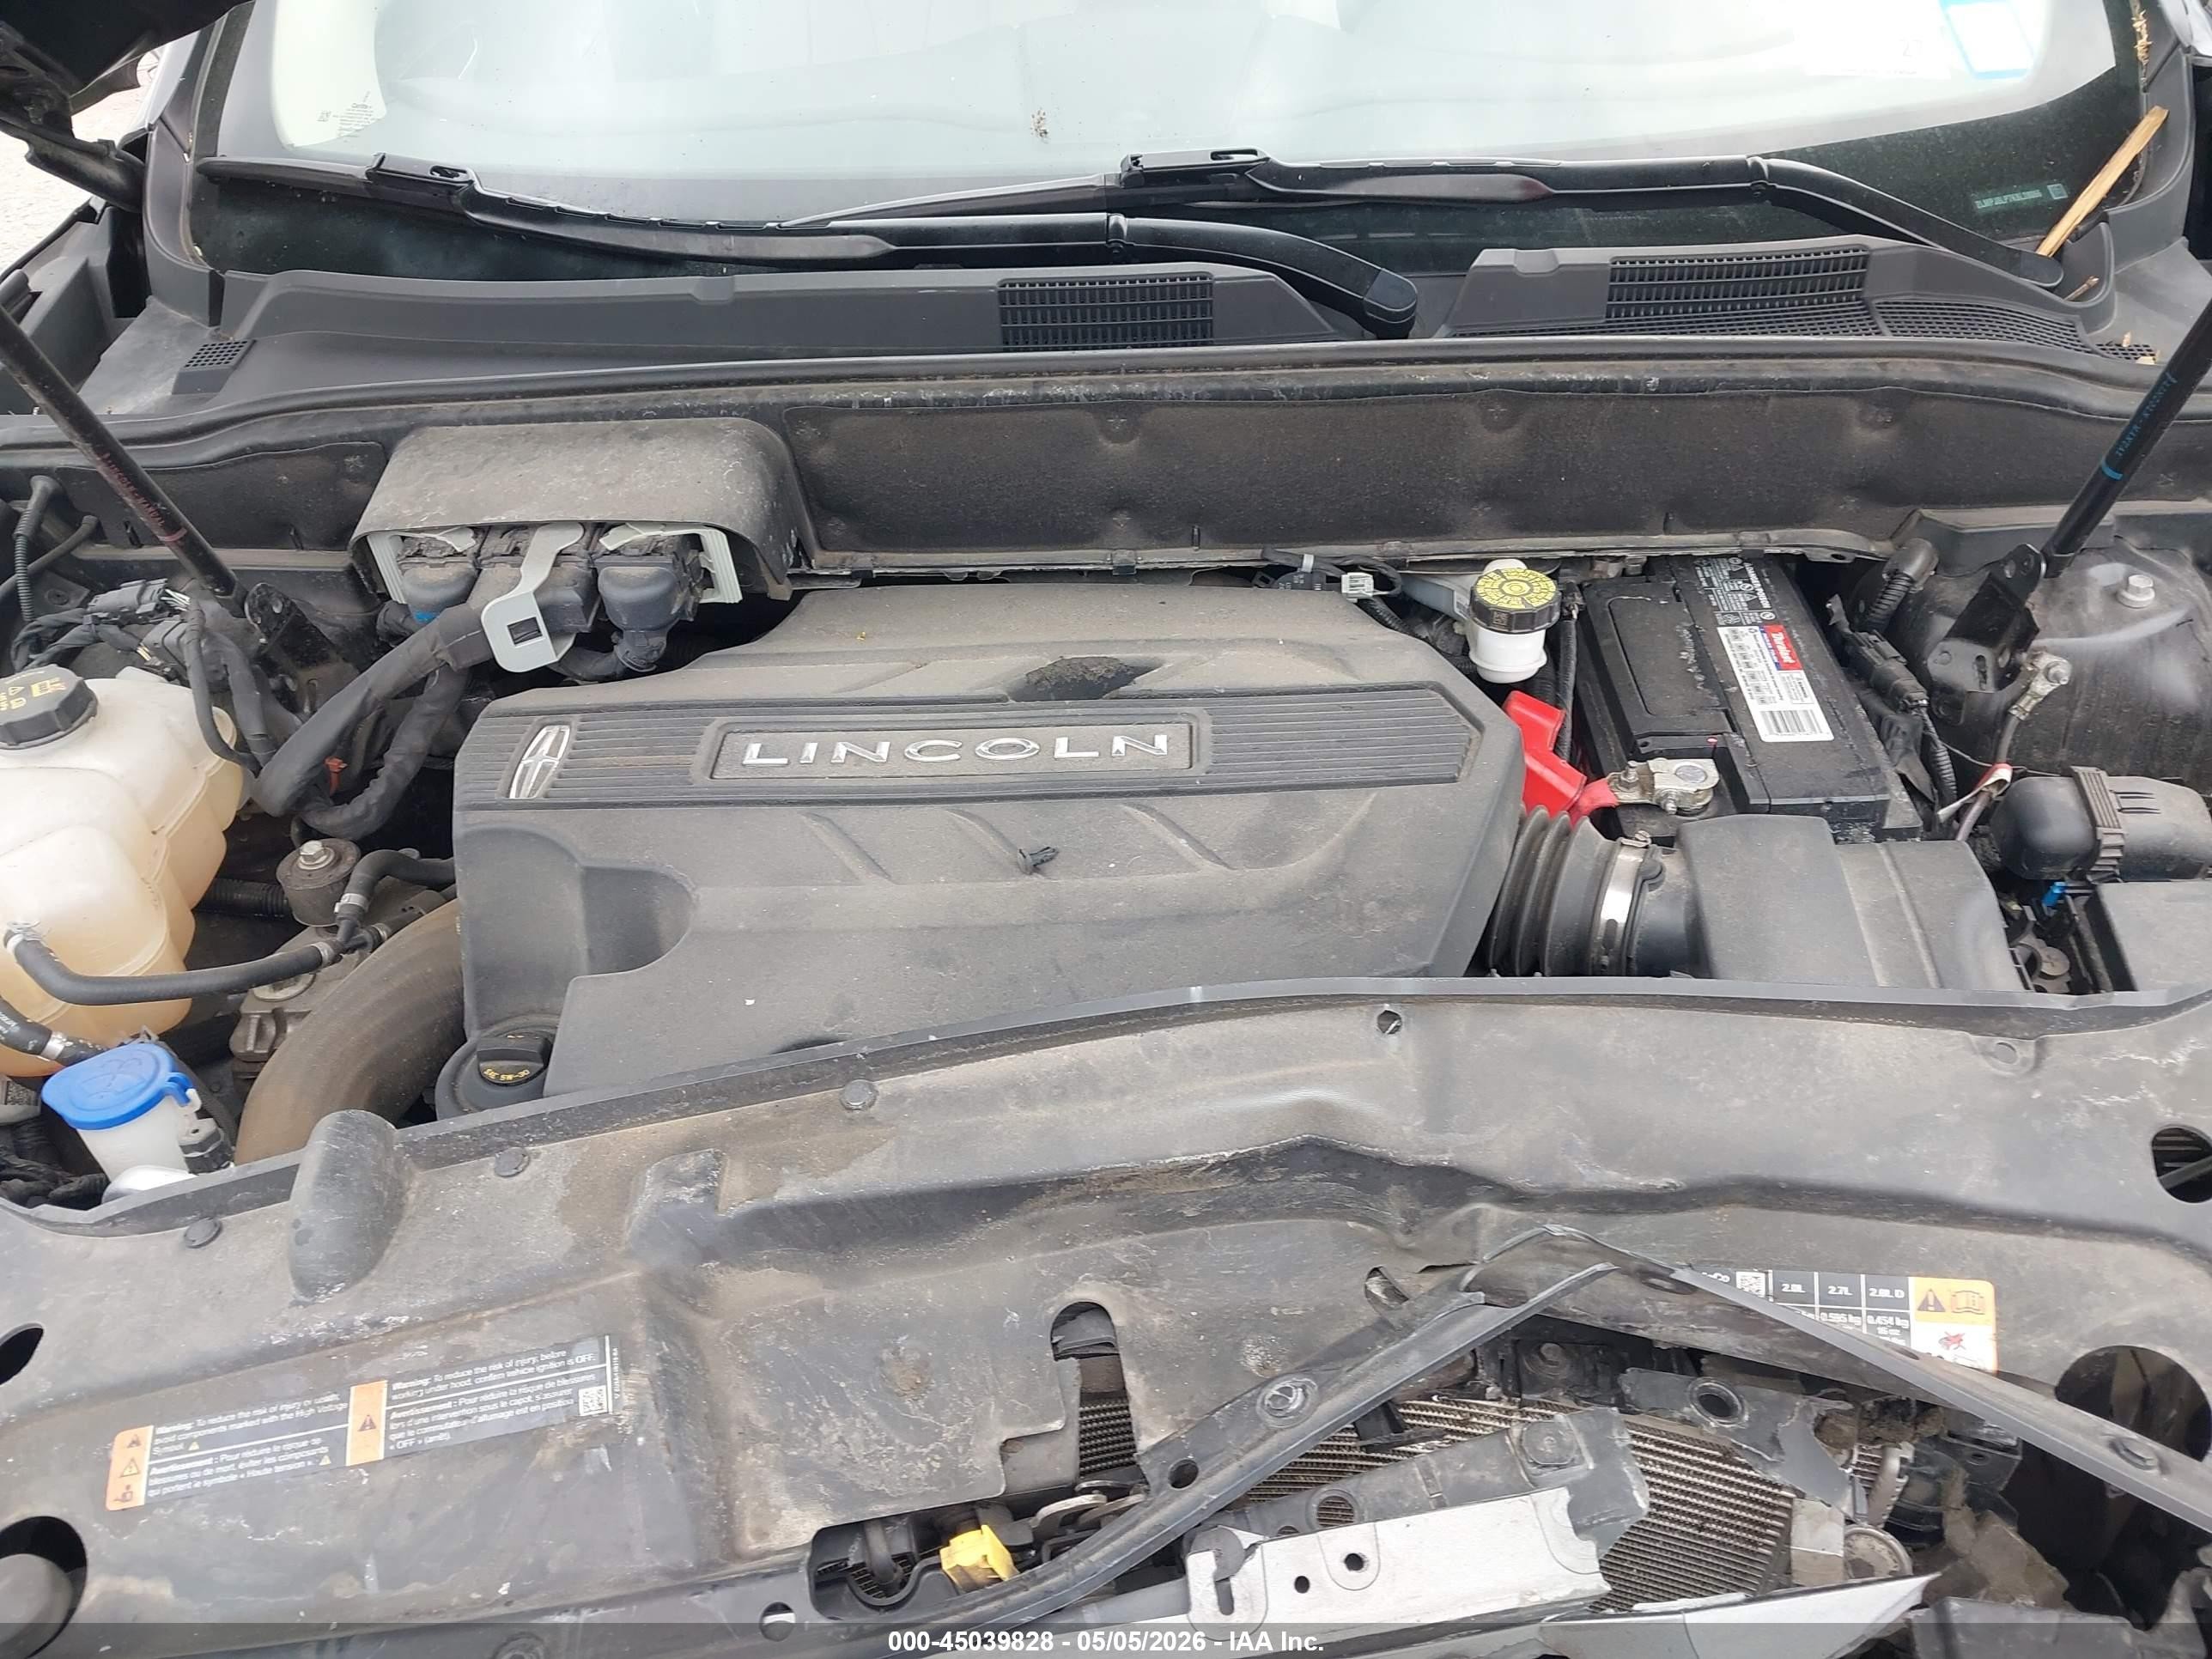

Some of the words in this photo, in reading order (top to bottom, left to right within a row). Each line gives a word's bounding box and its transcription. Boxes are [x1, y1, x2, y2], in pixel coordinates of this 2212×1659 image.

[1771, 631, 1796, 664] Duralast
[742, 734, 1168, 765] LINCOLN
[1827, 1285, 1853, 1296] 2.7L
